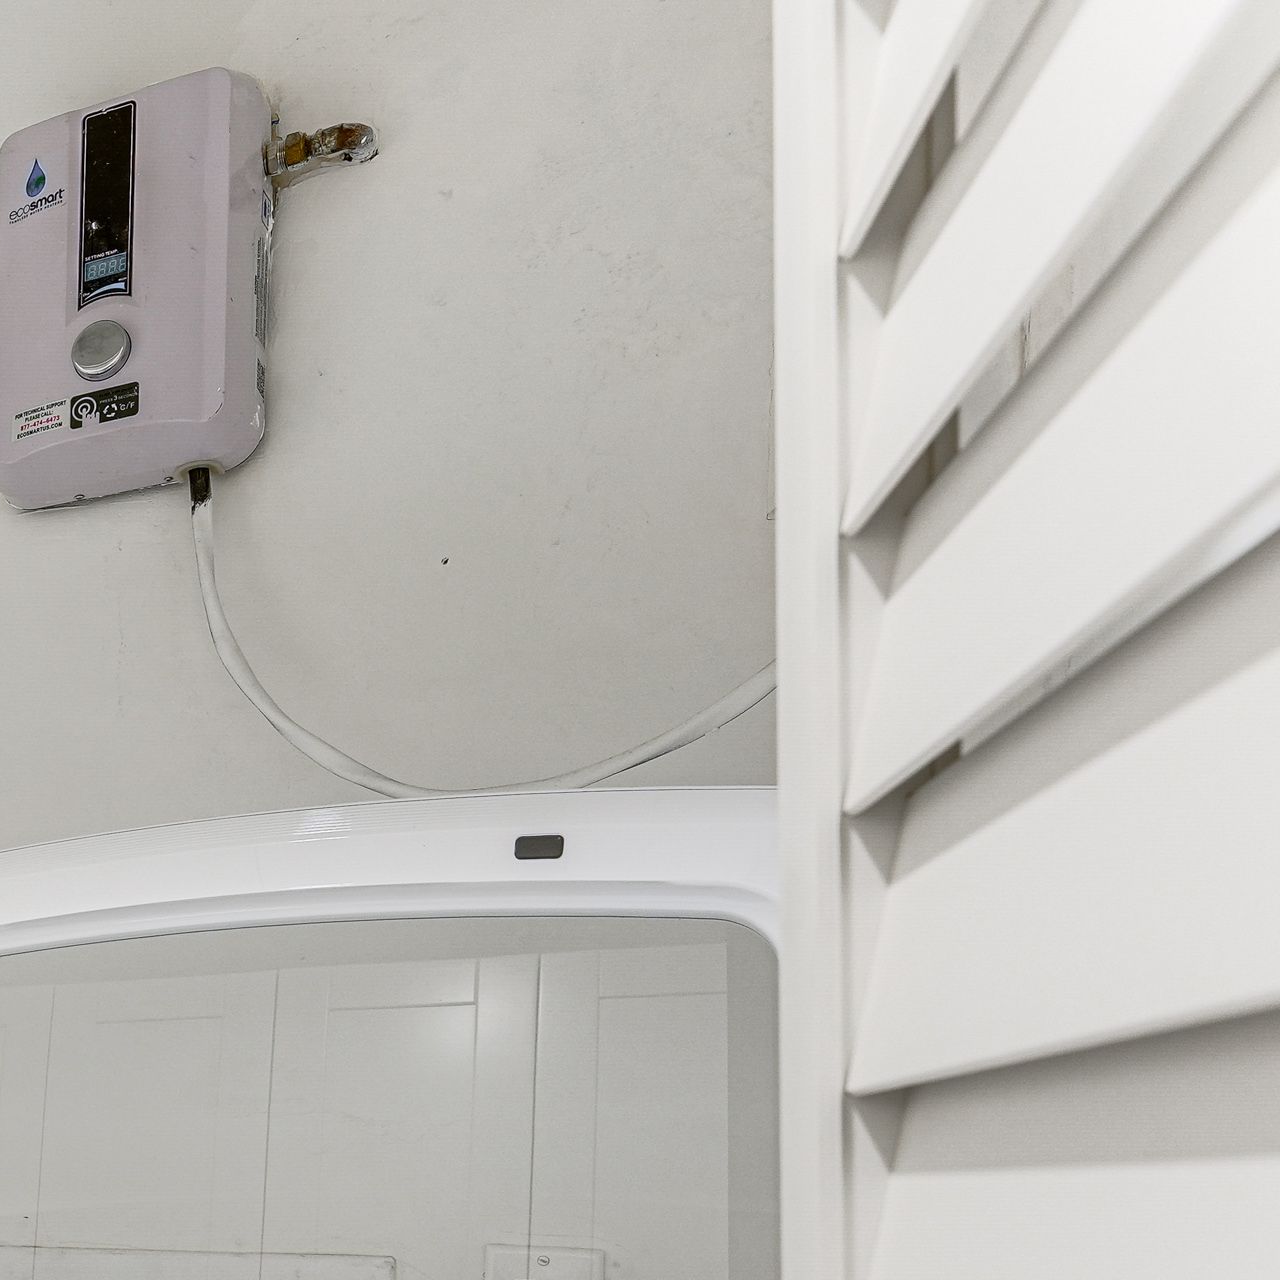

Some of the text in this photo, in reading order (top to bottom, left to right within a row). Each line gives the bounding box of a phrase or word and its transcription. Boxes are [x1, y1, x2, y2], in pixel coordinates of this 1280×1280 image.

[9, 189, 65, 221] ecosmart
[14, 400, 67, 421] FOR TECHNICAL SUPPORT
[25, 413, 41, 423] PLEASE
[16, 422, 63, 440] ECOSMARTUS.COM
